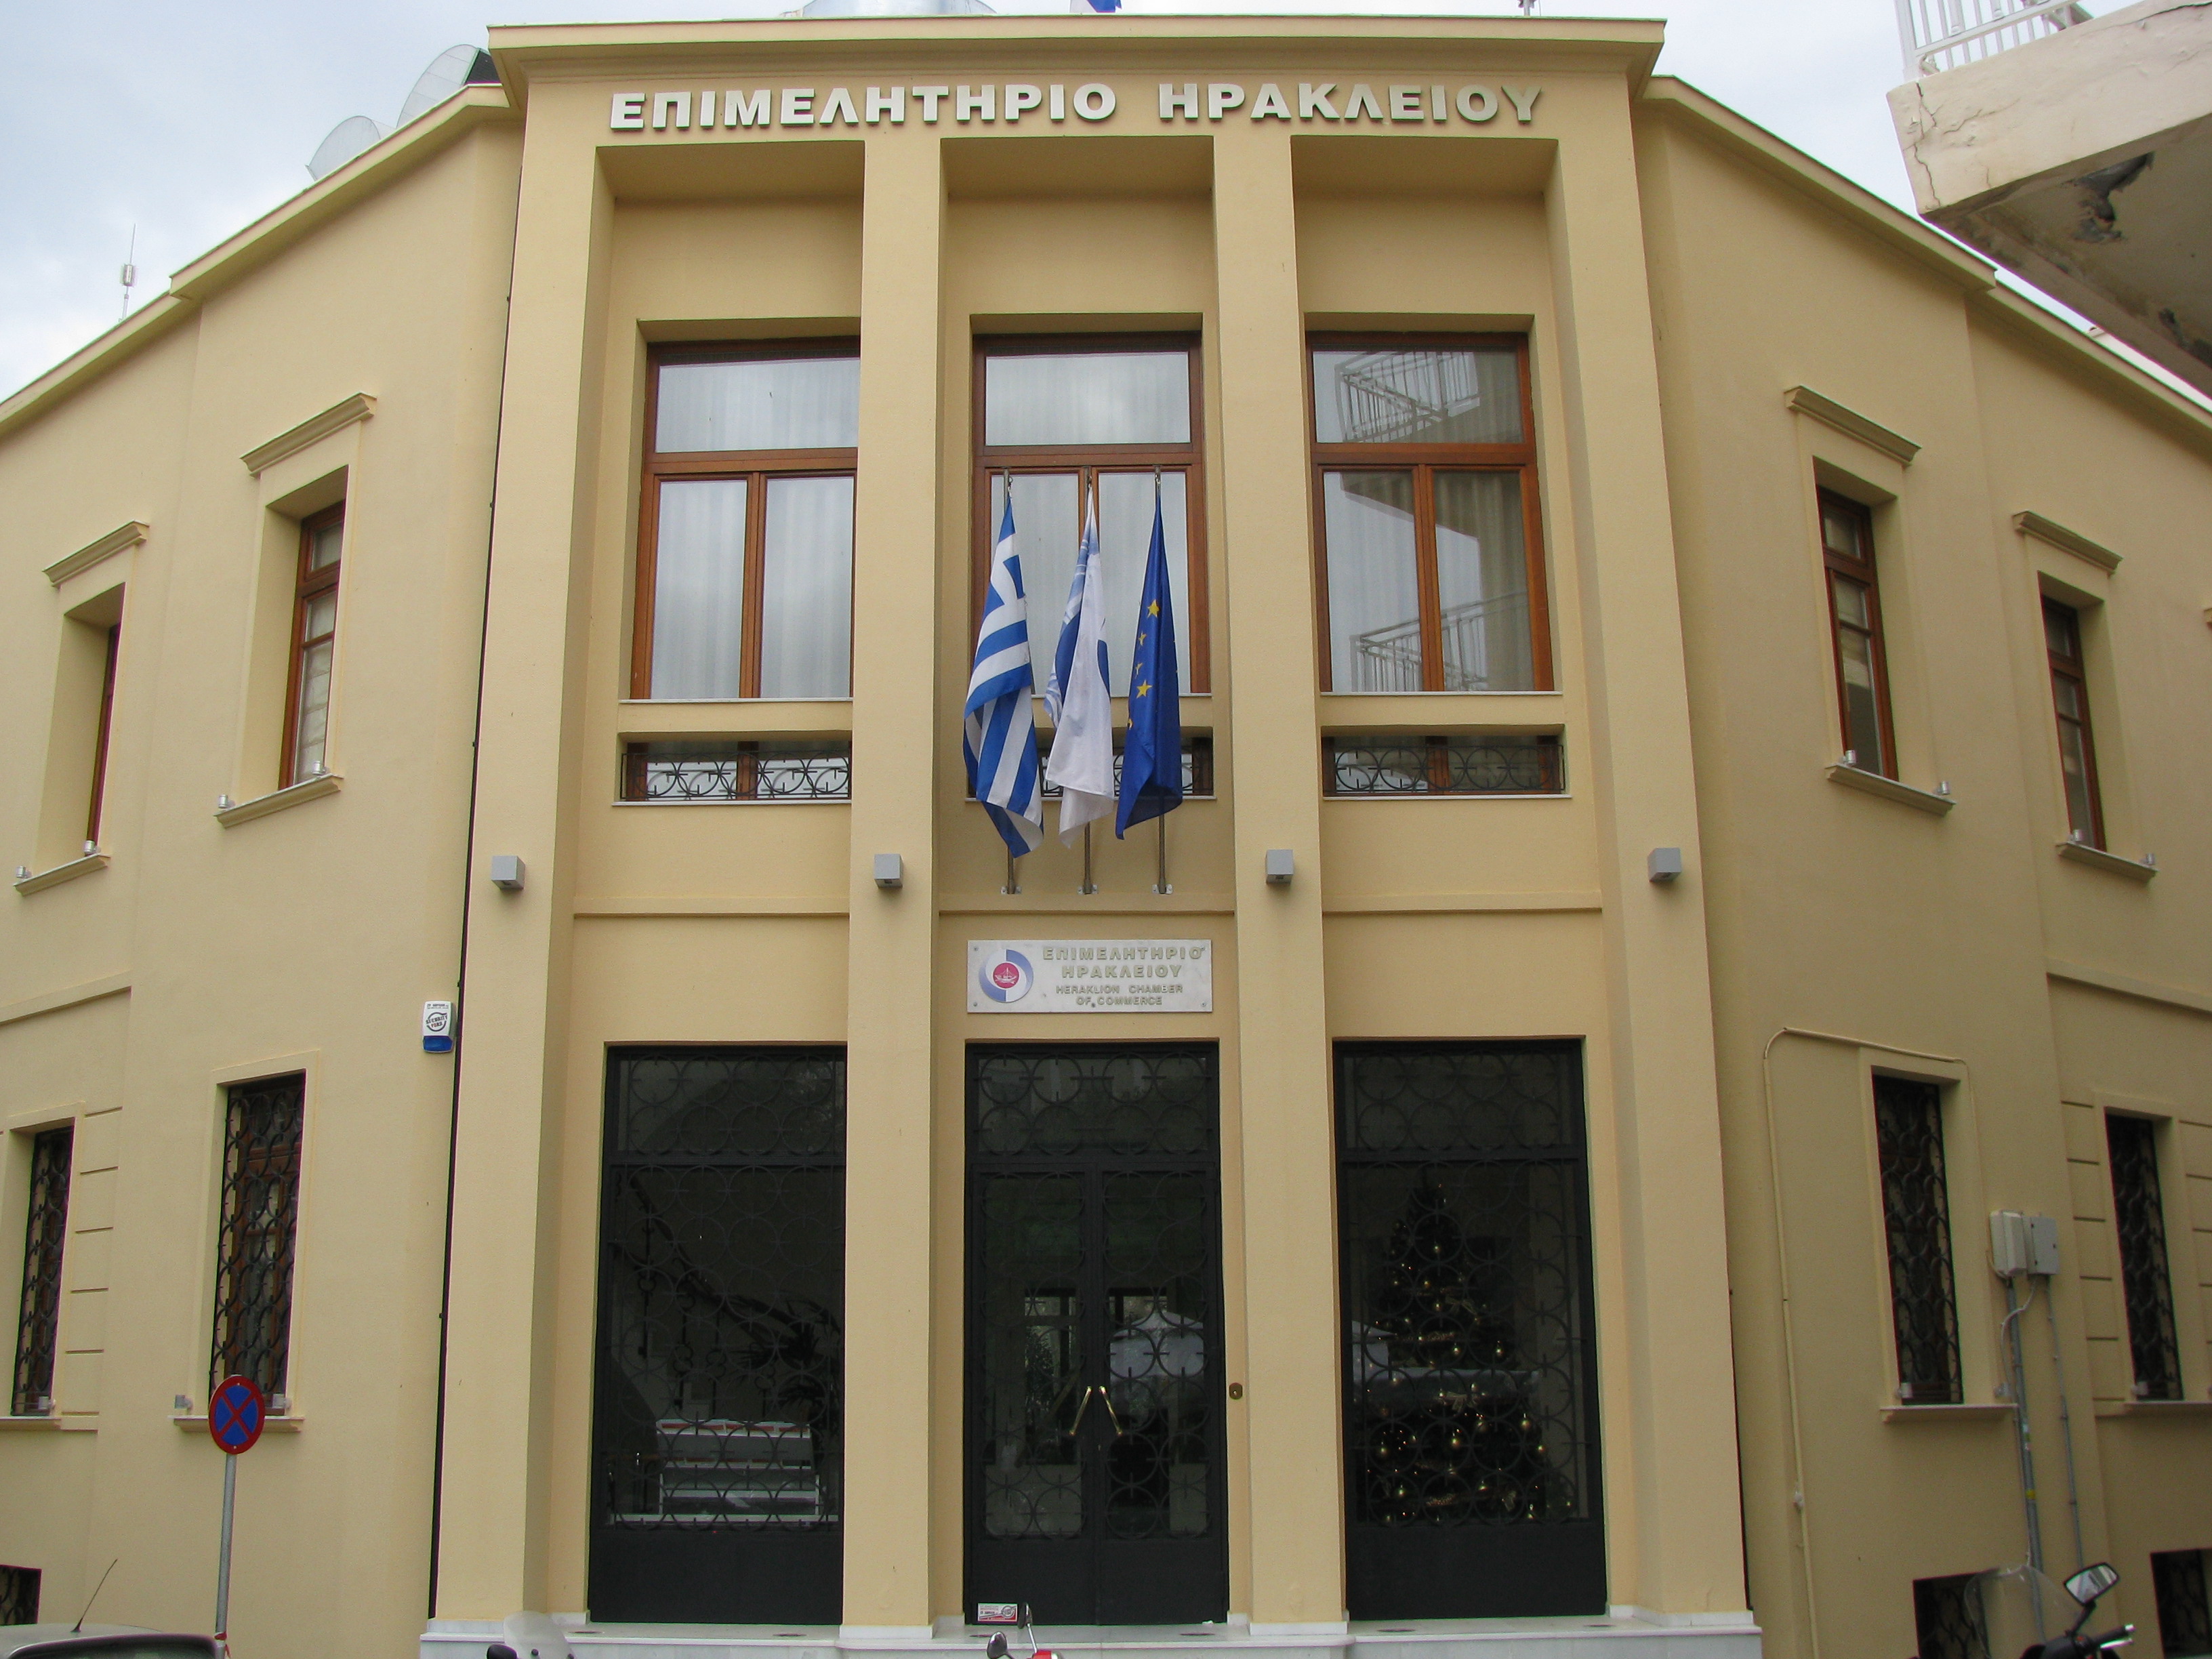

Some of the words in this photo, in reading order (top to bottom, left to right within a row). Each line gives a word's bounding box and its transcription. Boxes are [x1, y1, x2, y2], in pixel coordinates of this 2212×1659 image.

[610, 83, 1117, 130] ΕΠΙΜΕΛΗΤΗΡΙΟ
[1159, 83, 1542, 123] ΗΡΑΚΛΕΙΟΥ
[1042, 946, 1204, 960] ΕΠΙΜΕΛΗΤΗΡΙΟ
[1062, 964, 1182, 978] ΗΡΑΚΛΕΙΟΥ
[1055, 984, 1120, 994] HERAKLION
[1128, 984, 1183, 994] CHAMBER
[1076, 996, 1091, 1006] OF
[1097, 996, 1163, 1006] COMMERCE
